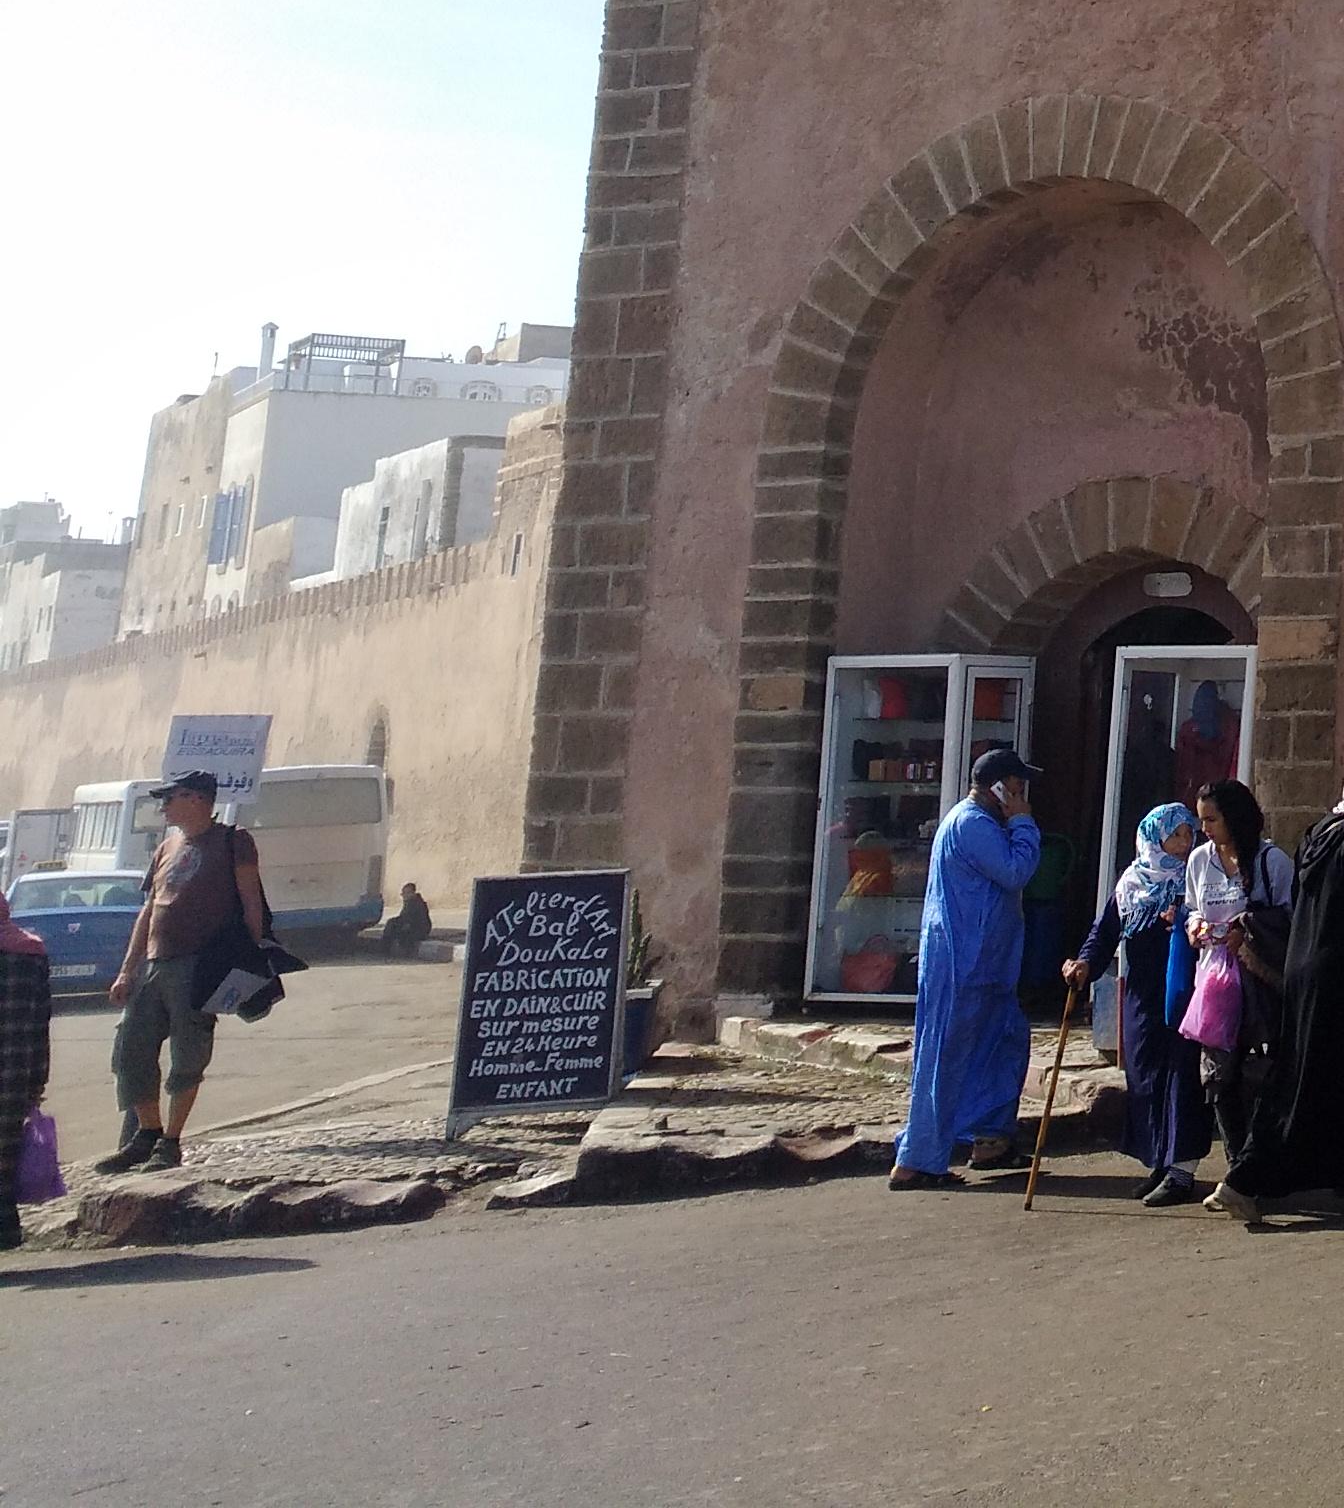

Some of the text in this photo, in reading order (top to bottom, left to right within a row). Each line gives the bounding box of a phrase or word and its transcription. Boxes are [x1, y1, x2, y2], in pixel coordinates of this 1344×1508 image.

[528, 911, 581, 937] Bab
[470, 999, 501, 1018] EN
[521, 1014, 600, 1035] mesure
[481, 1034, 598, 1057] EN 24 Heure
[495, 1077, 578, 1100] ENFANT
